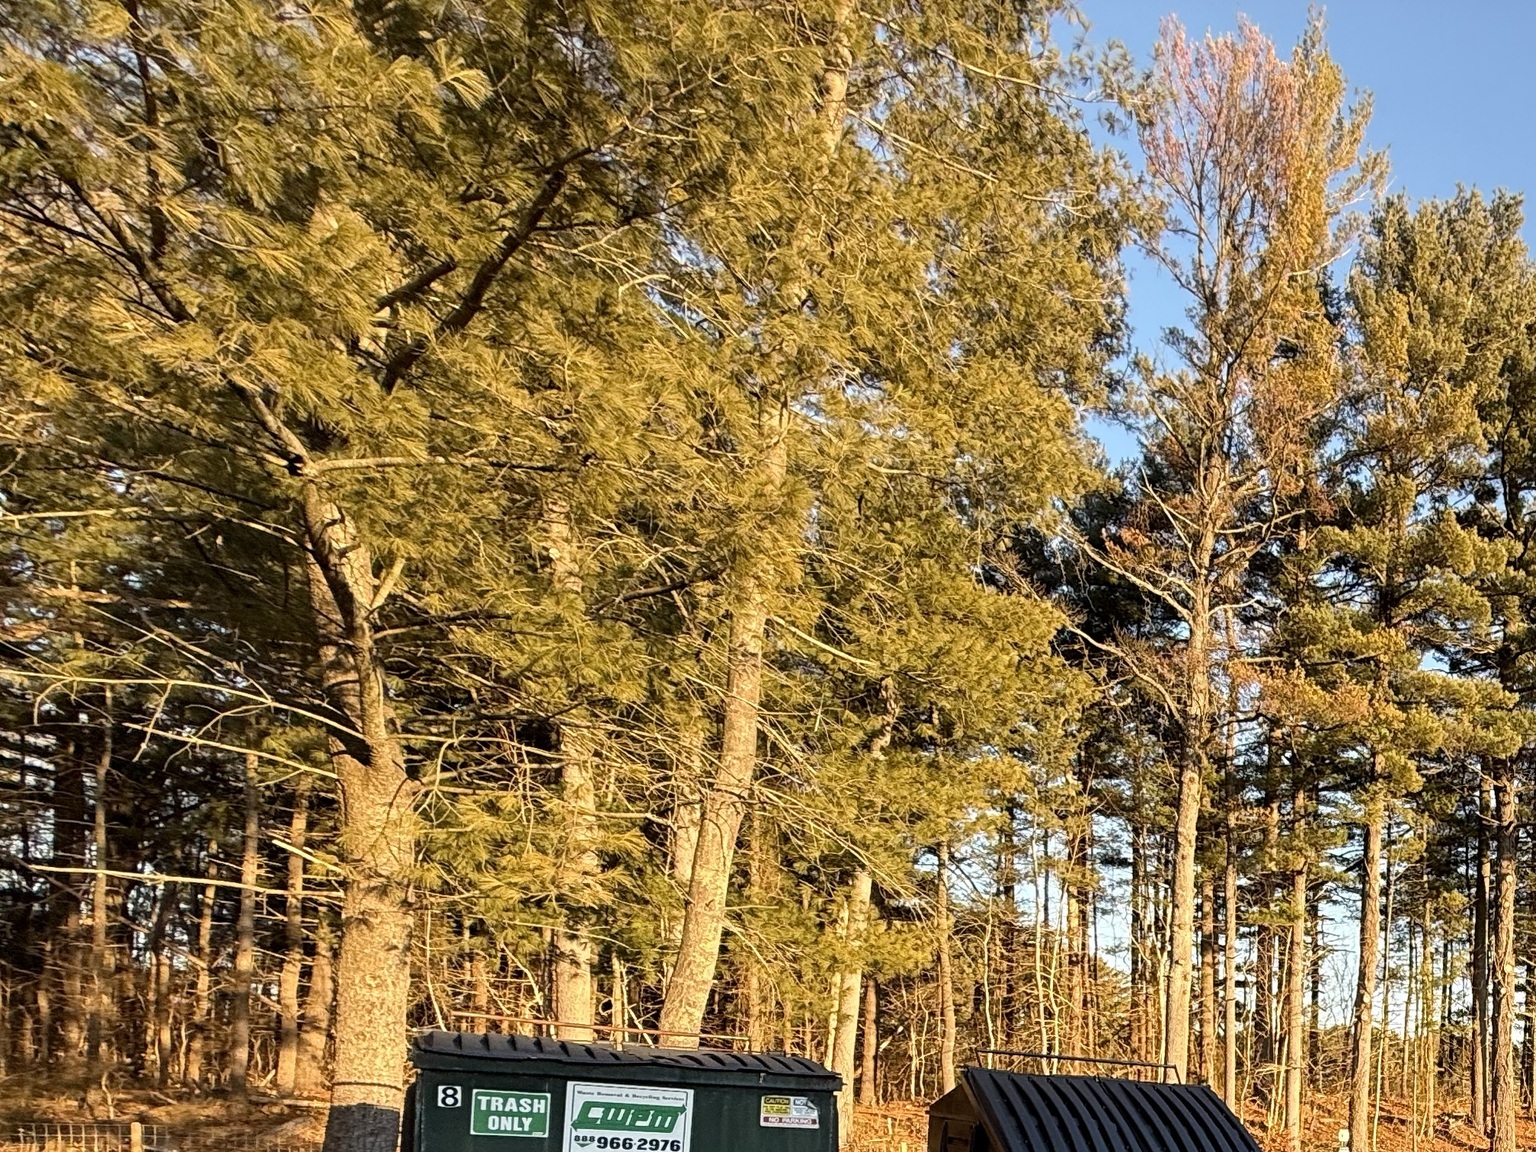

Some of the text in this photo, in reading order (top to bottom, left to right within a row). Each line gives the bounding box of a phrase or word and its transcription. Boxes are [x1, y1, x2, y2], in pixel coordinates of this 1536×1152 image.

[441, 1086, 459, 1107] 8
[477, 1096, 546, 1114] TRASH
[487, 1115, 533, 1132] ONLY
[574, 1135, 596, 1143] 888
